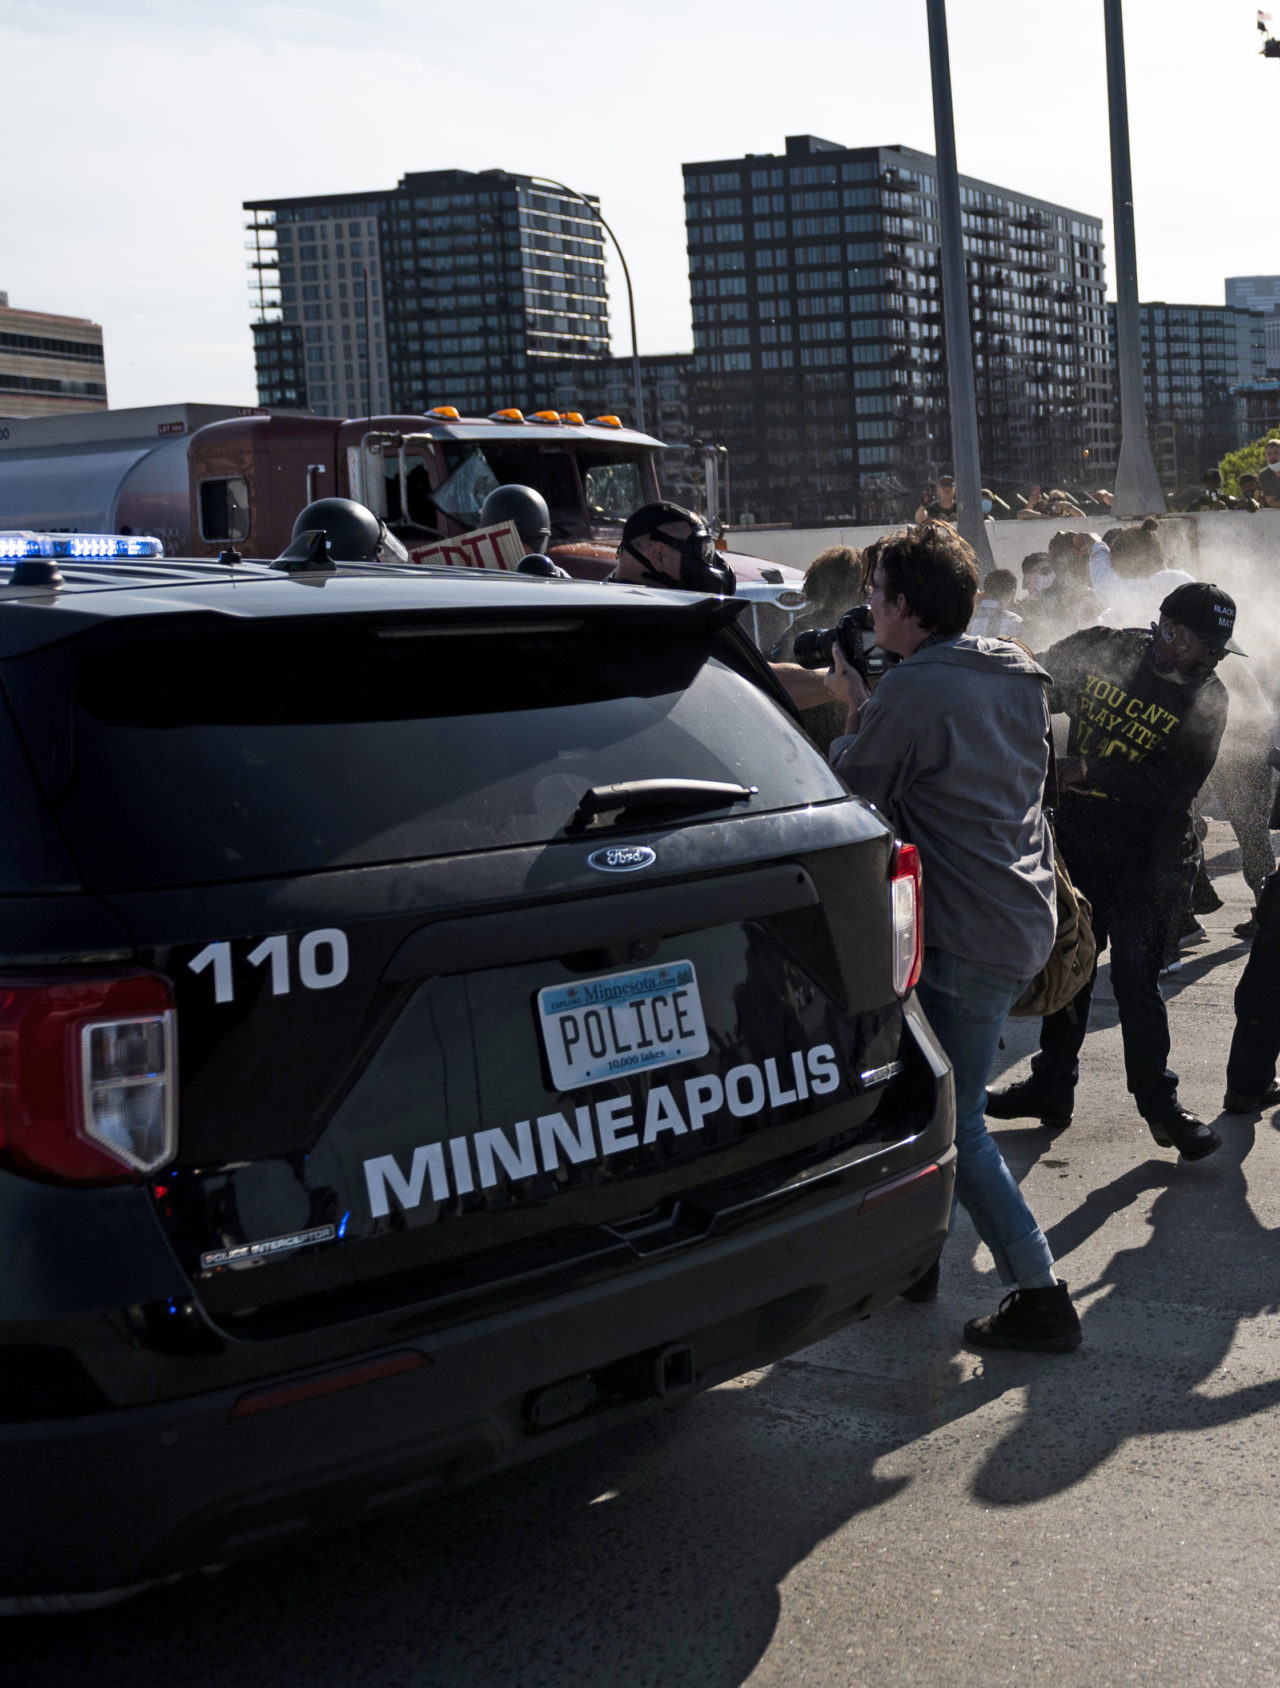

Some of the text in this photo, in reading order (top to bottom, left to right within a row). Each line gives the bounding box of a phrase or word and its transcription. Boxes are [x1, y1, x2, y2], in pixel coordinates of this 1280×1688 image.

[1080, 696, 1162, 750] PLAY ITH
[1085, 674, 1180, 734] YOU CN'T
[606, 847, 643, 866] Ford
[187, 928, 350, 1004] 110
[559, 990, 695, 1066] POLICE
[608, 1050, 666, 1070] 10,000 lakes
[362, 1043, 840, 1219] MINNEAPOLIS
[205, 1228, 331, 1264] POLICE INTERCEPTOR
